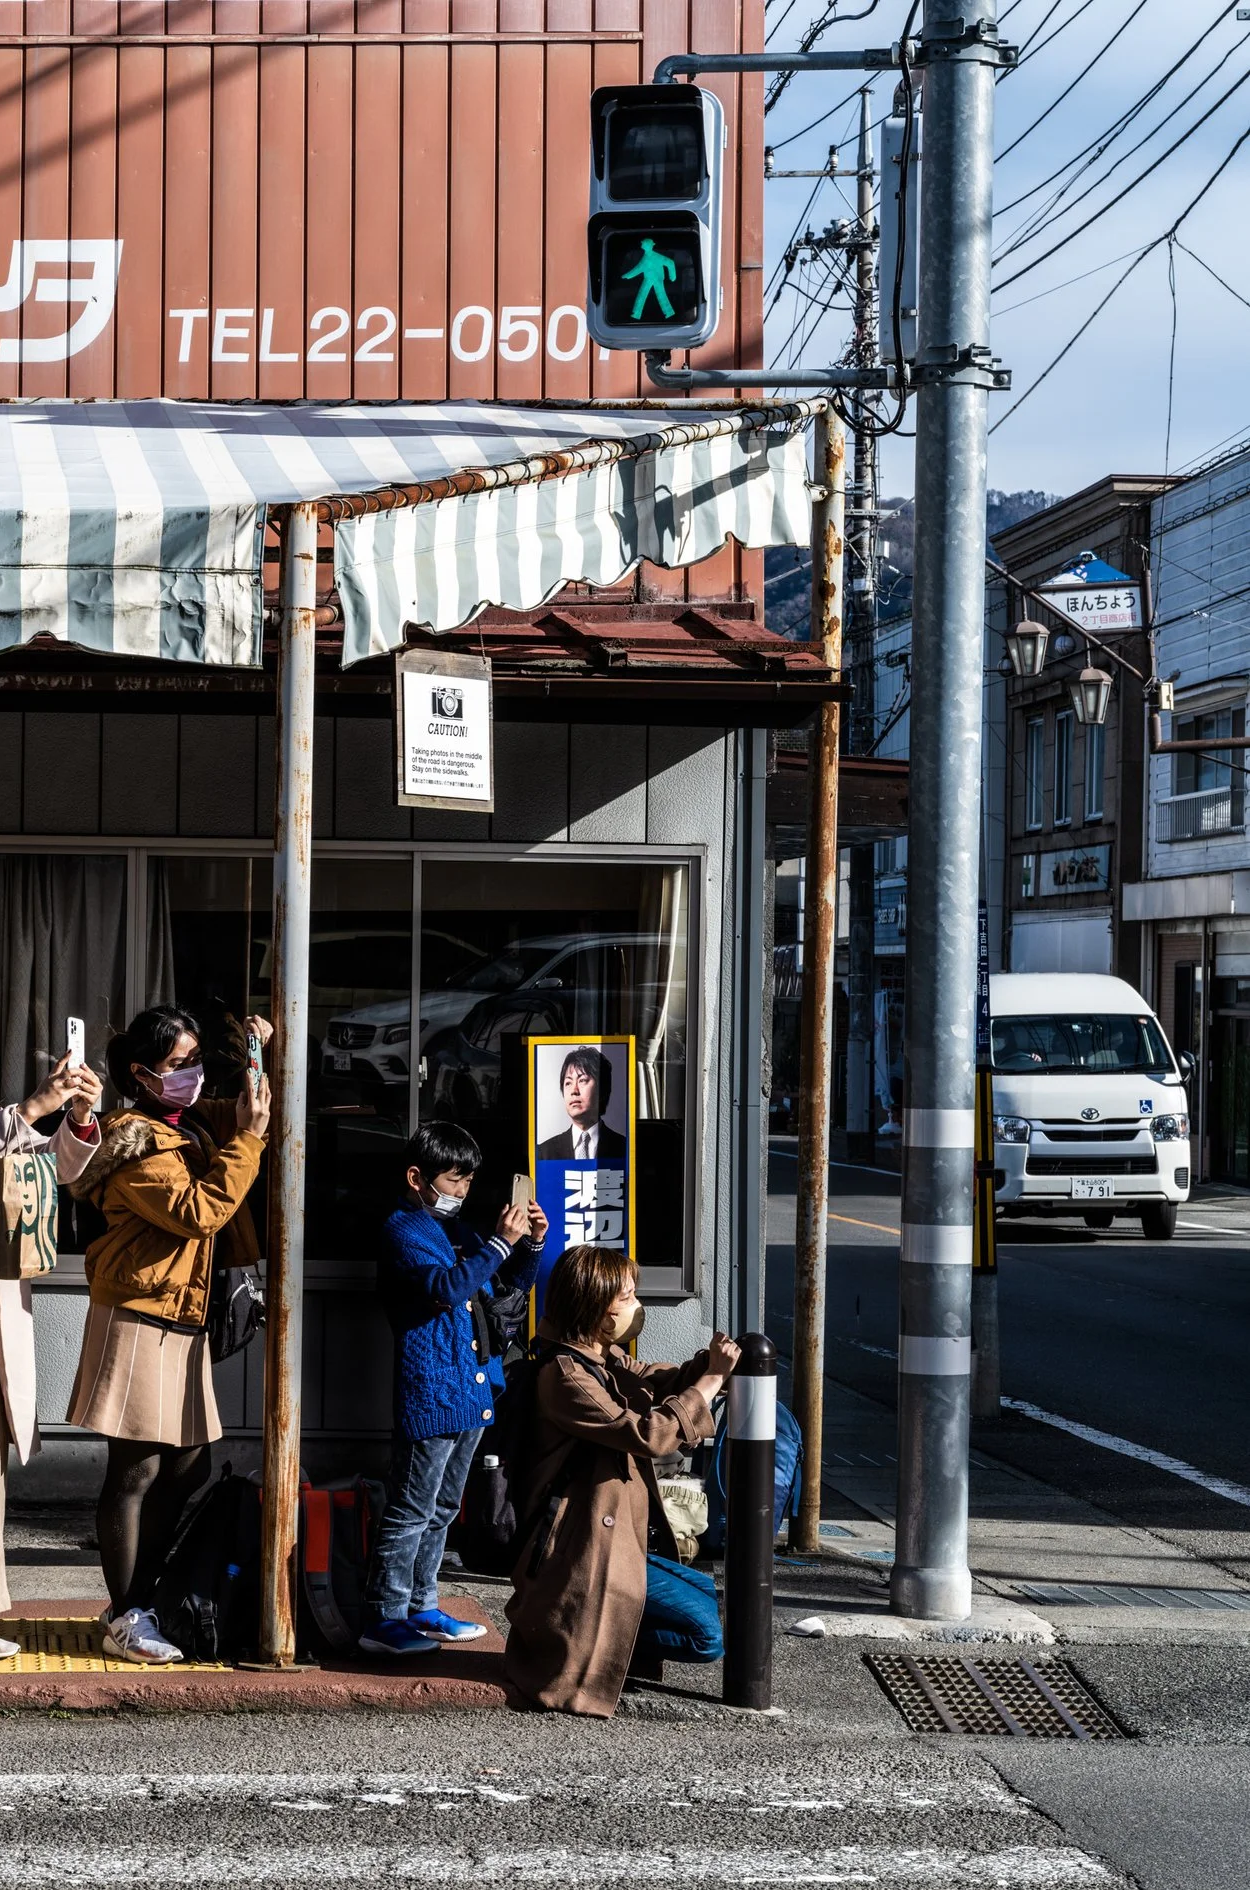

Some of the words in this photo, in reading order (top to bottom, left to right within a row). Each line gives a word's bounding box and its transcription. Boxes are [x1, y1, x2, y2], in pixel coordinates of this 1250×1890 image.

[168, 305, 611, 362] TEL22-050
[1066, 592, 1136, 613] ほんちょう
[428, 722, 468, 737] CAUTION!
[411, 747, 429, 757] Taking
[430, 749, 448, 757] photos
[465, 752, 482, 760] middle
[412, 764, 423, 773] Stay
[433, 766, 441, 774] the
[442, 768, 469, 776] sidewalks.
[447, 760, 475, 768] dangerous.
[980, 919, 989, 996] 下吉田一丁目
[981, 1002, 988, 1017] 4
[564, 1168, 625, 1251] 渡辺
